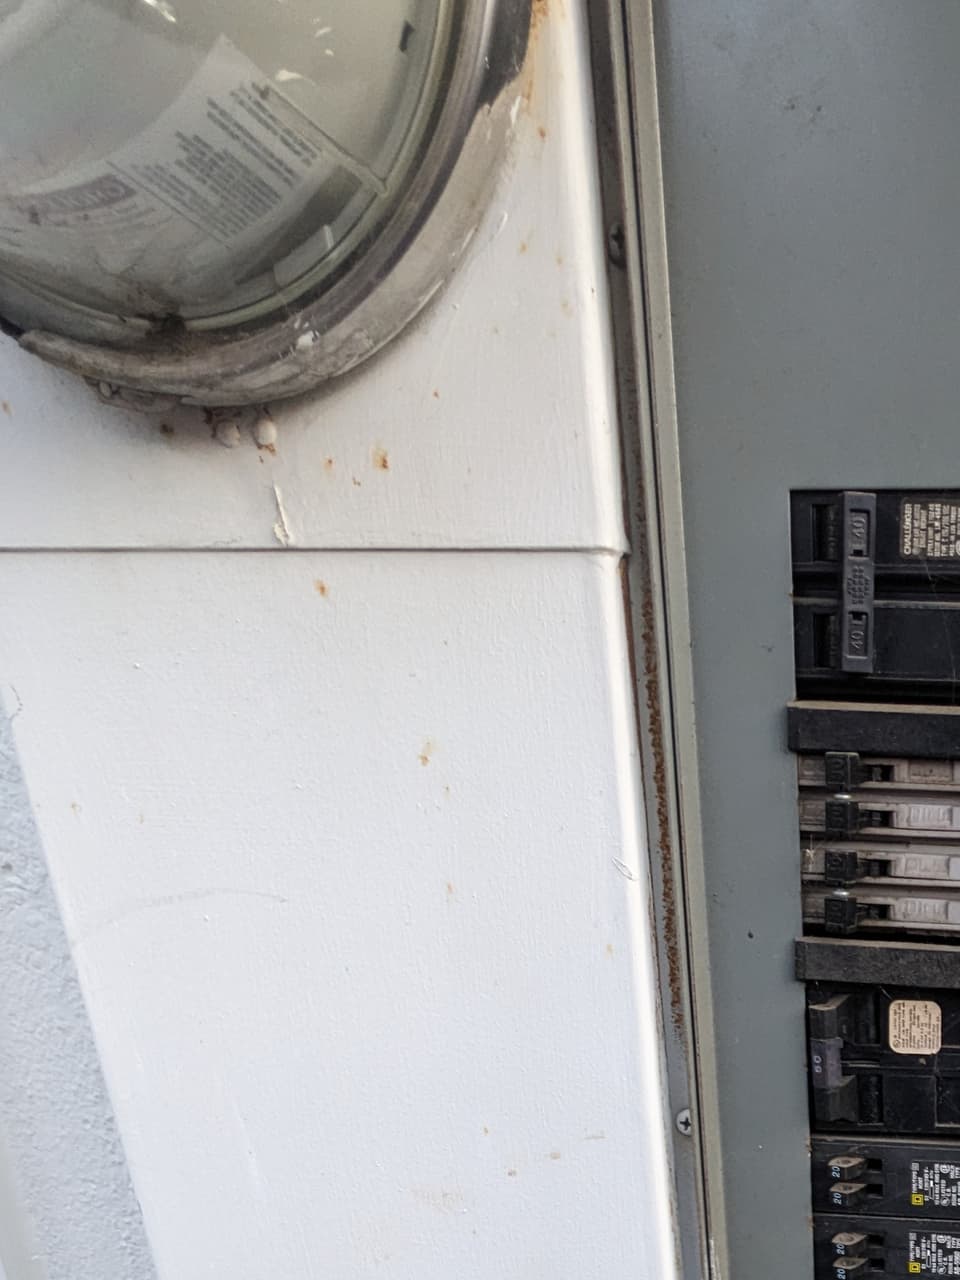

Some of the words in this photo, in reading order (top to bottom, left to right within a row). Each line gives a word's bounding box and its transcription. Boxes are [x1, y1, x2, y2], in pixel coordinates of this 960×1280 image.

[832, 1166, 841, 1178] 20
[833, 1192, 842, 1205] 20
[836, 1243, 845, 1255] 20
[837, 1268, 846, 1280] 20
